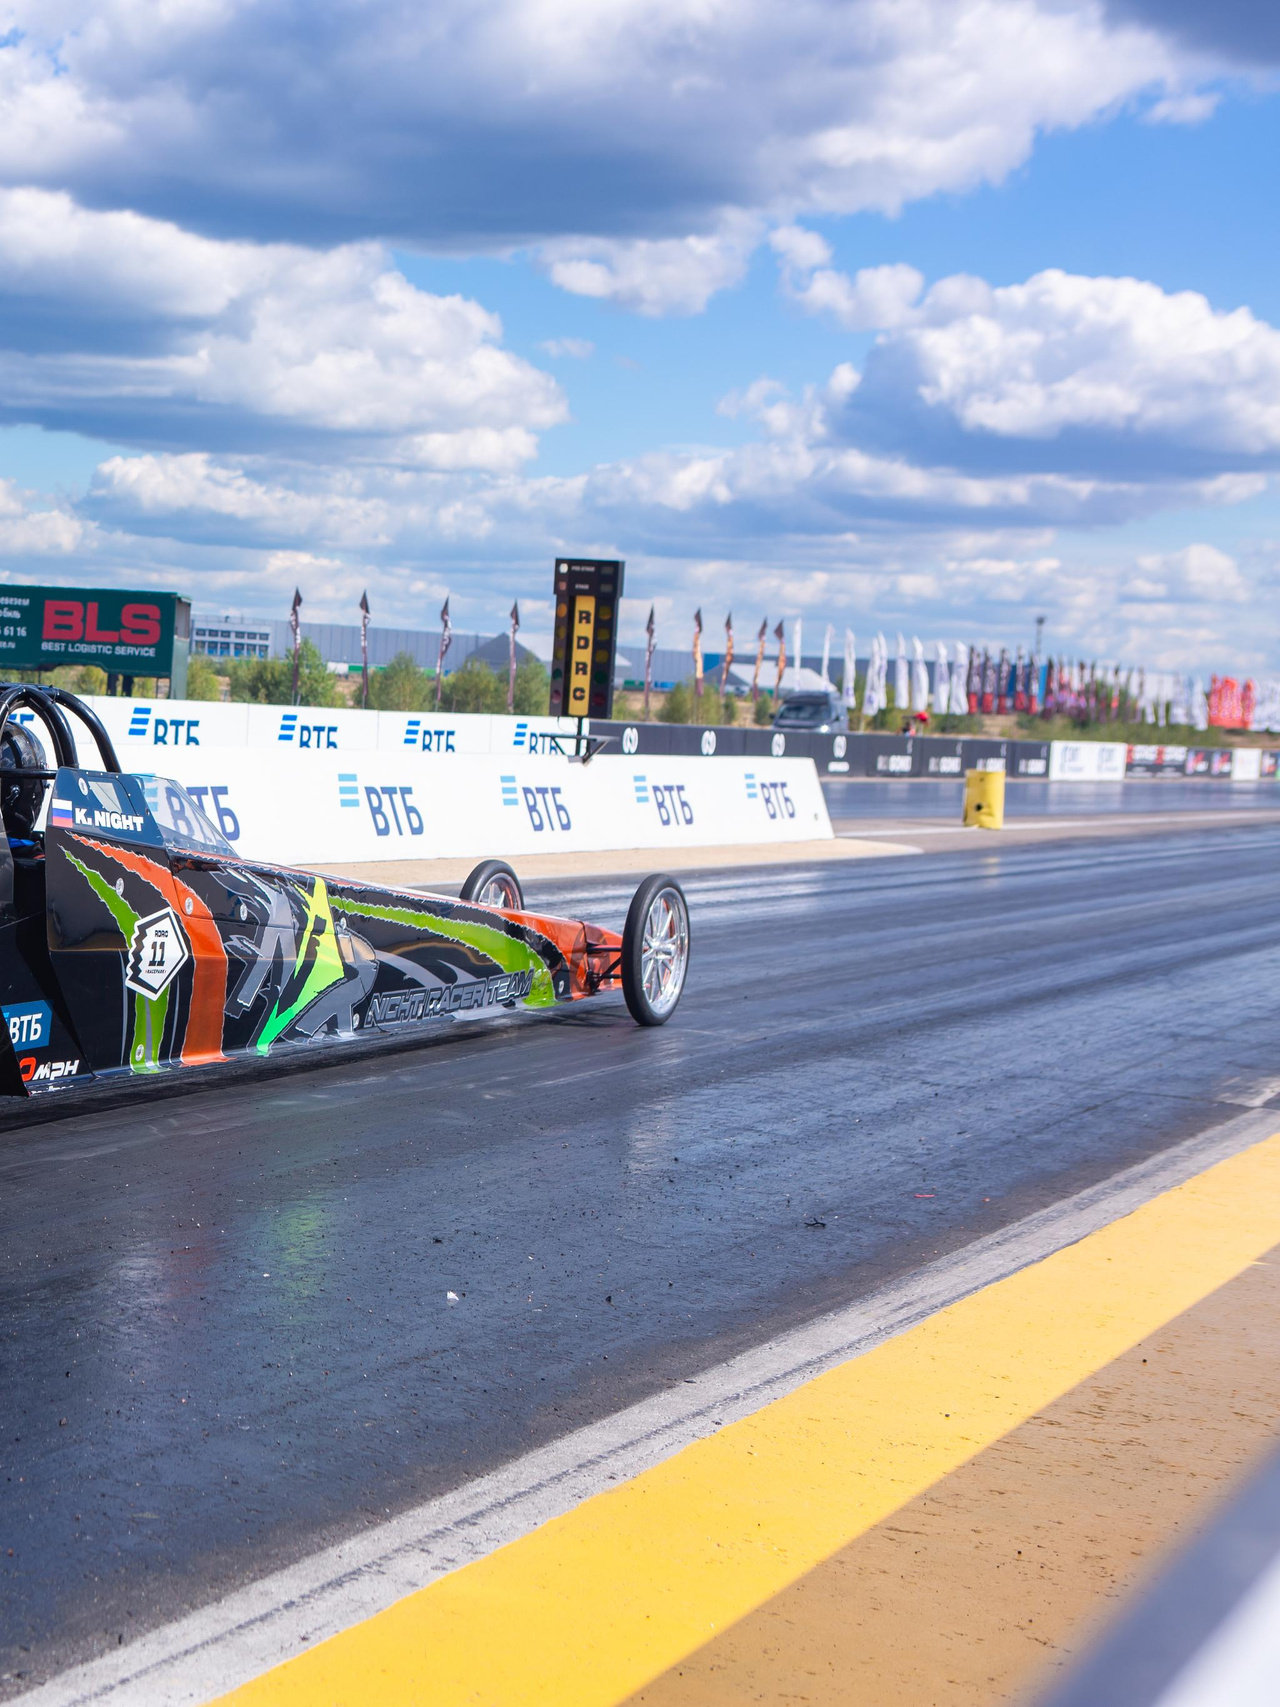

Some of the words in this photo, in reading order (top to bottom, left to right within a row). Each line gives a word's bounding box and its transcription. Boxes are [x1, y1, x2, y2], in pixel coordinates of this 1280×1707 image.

[4, 626, 15, 637] 61
[17, 627, 28, 637] 16
[42, 599, 161, 646] BLS
[41, 641, 66, 652] BEST
[68, 643, 113, 655] LOGISTIC
[114, 645, 156, 657] SERVICE
[364, 786, 424, 836] ВТБ
[522, 786, 572, 832] ВТБ
[652, 785, 694, 826] ВТБ
[760, 782, 795, 819] ВТБ
[74, 808, 93, 826] K.
[94, 811, 144, 832] NIGHT
[148, 941, 165, 966] 11
[366, 987, 426, 1026] NIGHT
[423, 978, 486, 1017] RACER
[488, 969, 534, 1006] TEAM
[10, 1013, 43, 1044] ВТБ
